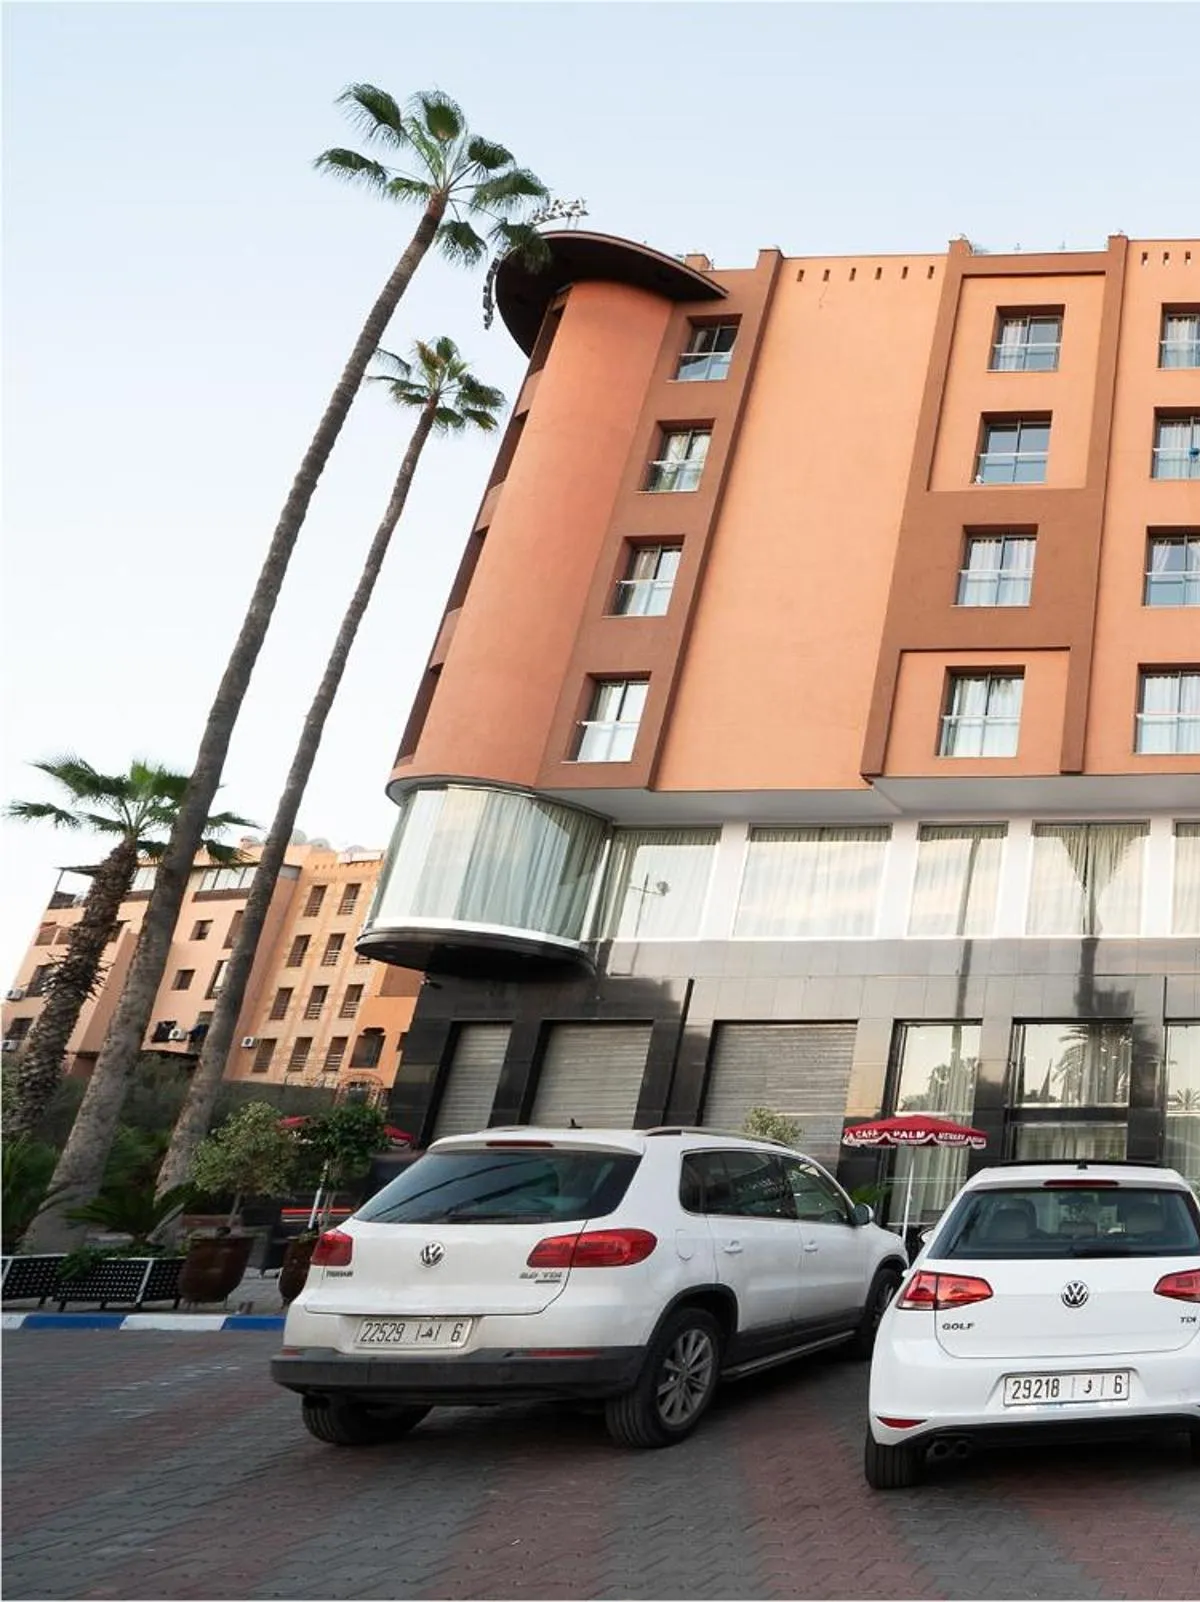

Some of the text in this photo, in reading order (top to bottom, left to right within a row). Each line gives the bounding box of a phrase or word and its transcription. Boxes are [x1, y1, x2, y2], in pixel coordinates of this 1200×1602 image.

[361, 1322, 406, 1342] 22529
[450, 1322, 464, 1342] 6
[942, 1322, 975, 1331] GOLF
[1012, 1378, 1061, 1400] 29218
[1113, 1374, 1123, 1395] 6
